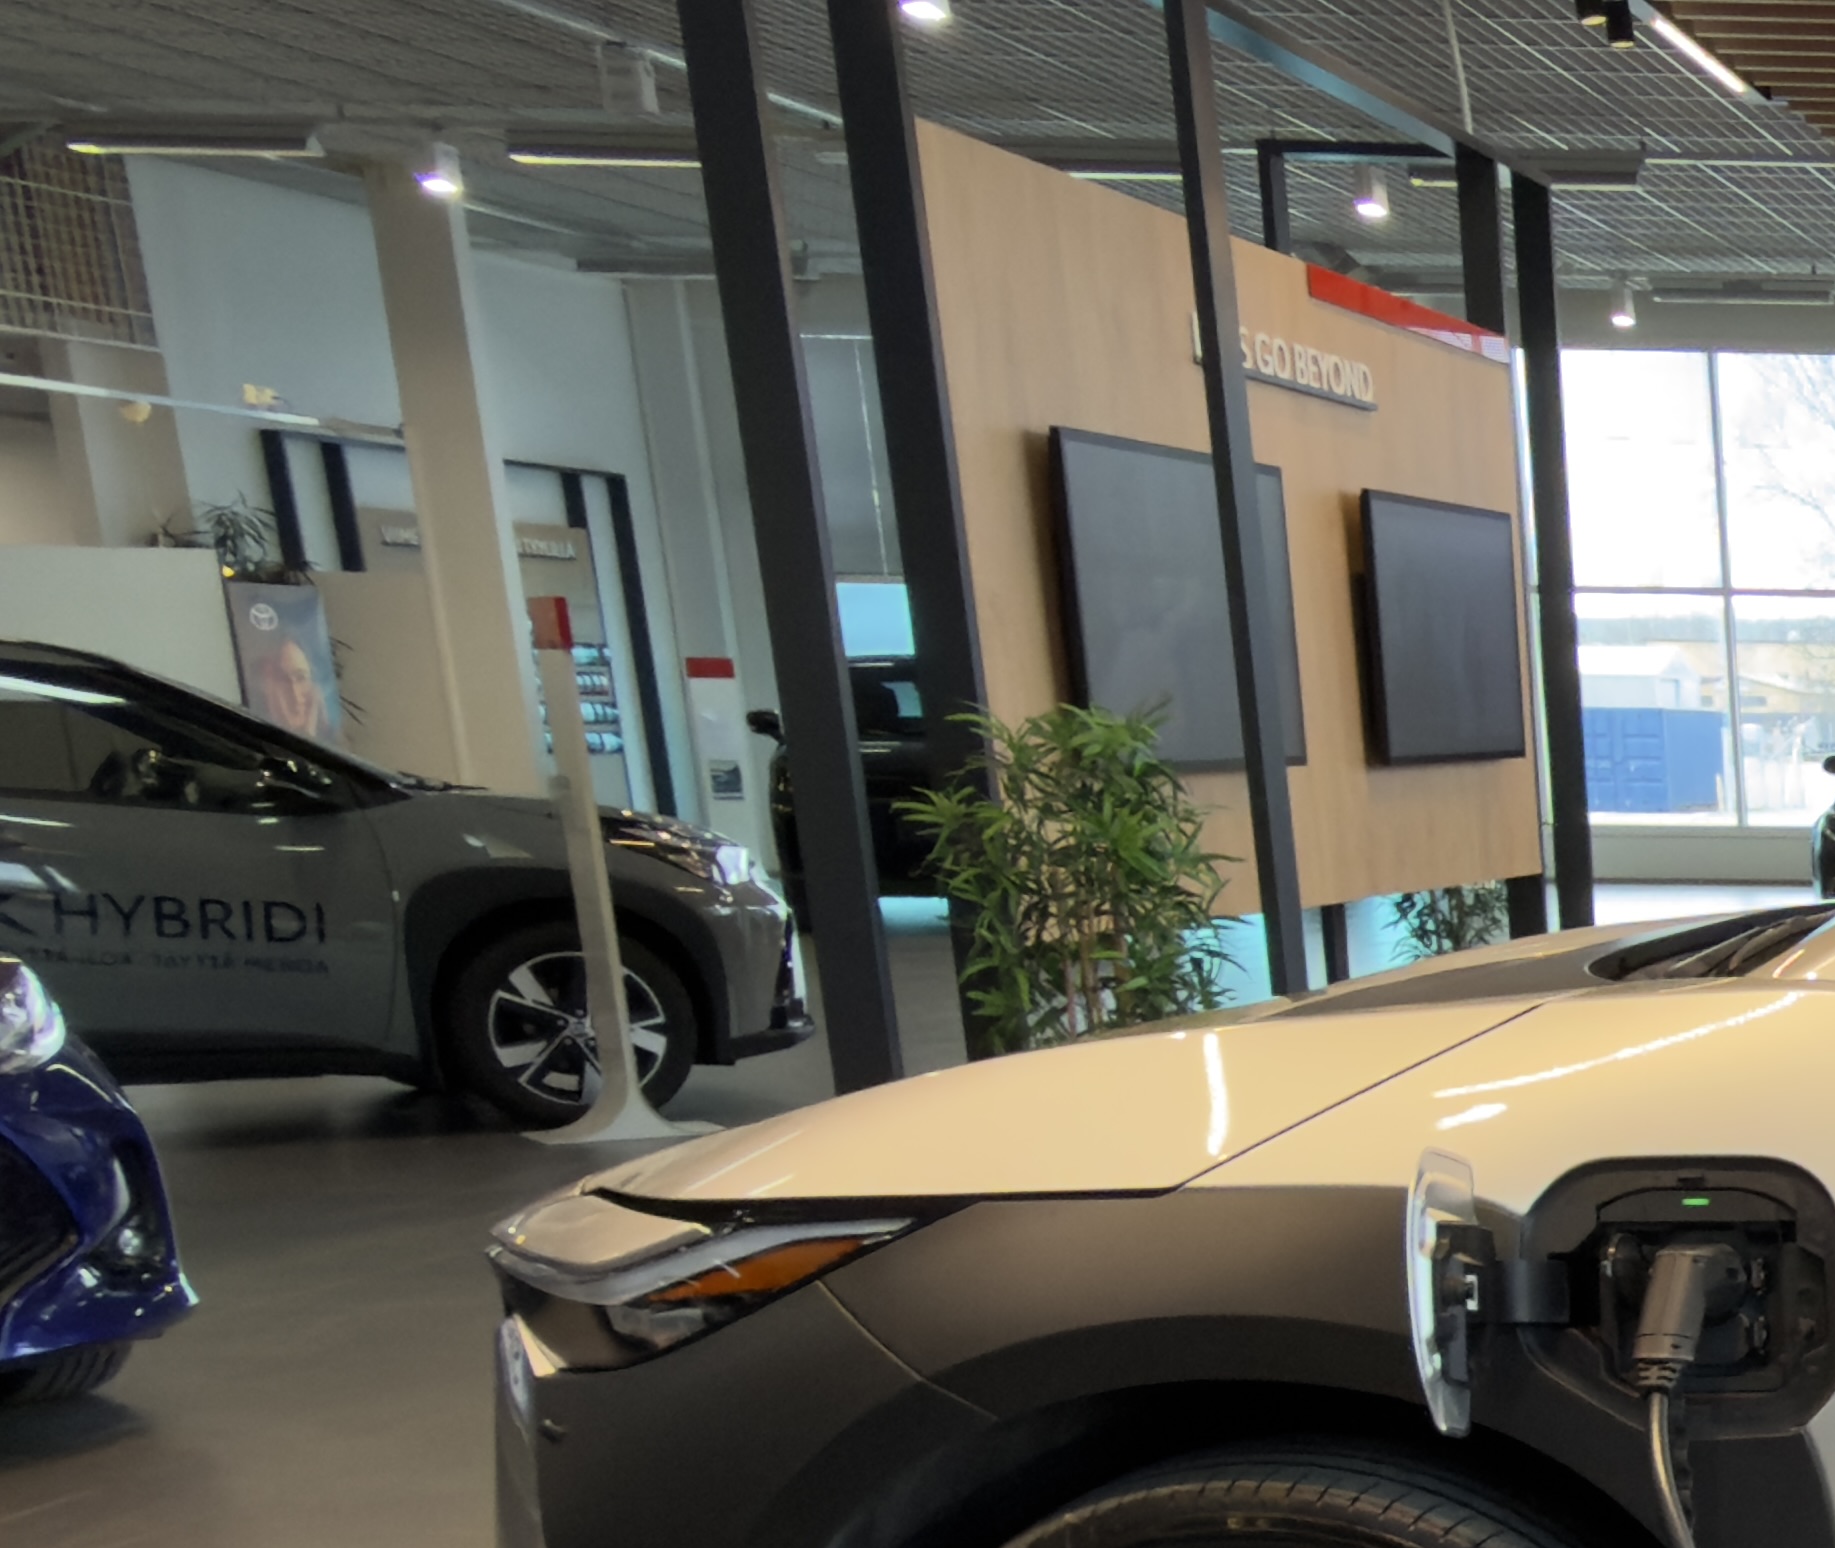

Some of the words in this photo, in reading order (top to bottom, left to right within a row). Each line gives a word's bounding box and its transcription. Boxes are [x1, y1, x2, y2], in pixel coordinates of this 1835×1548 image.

[1254, 332, 1291, 379] GO
[1293, 343, 1374, 402] BEYOND
[53, 891, 327, 944] HYBRIDI
